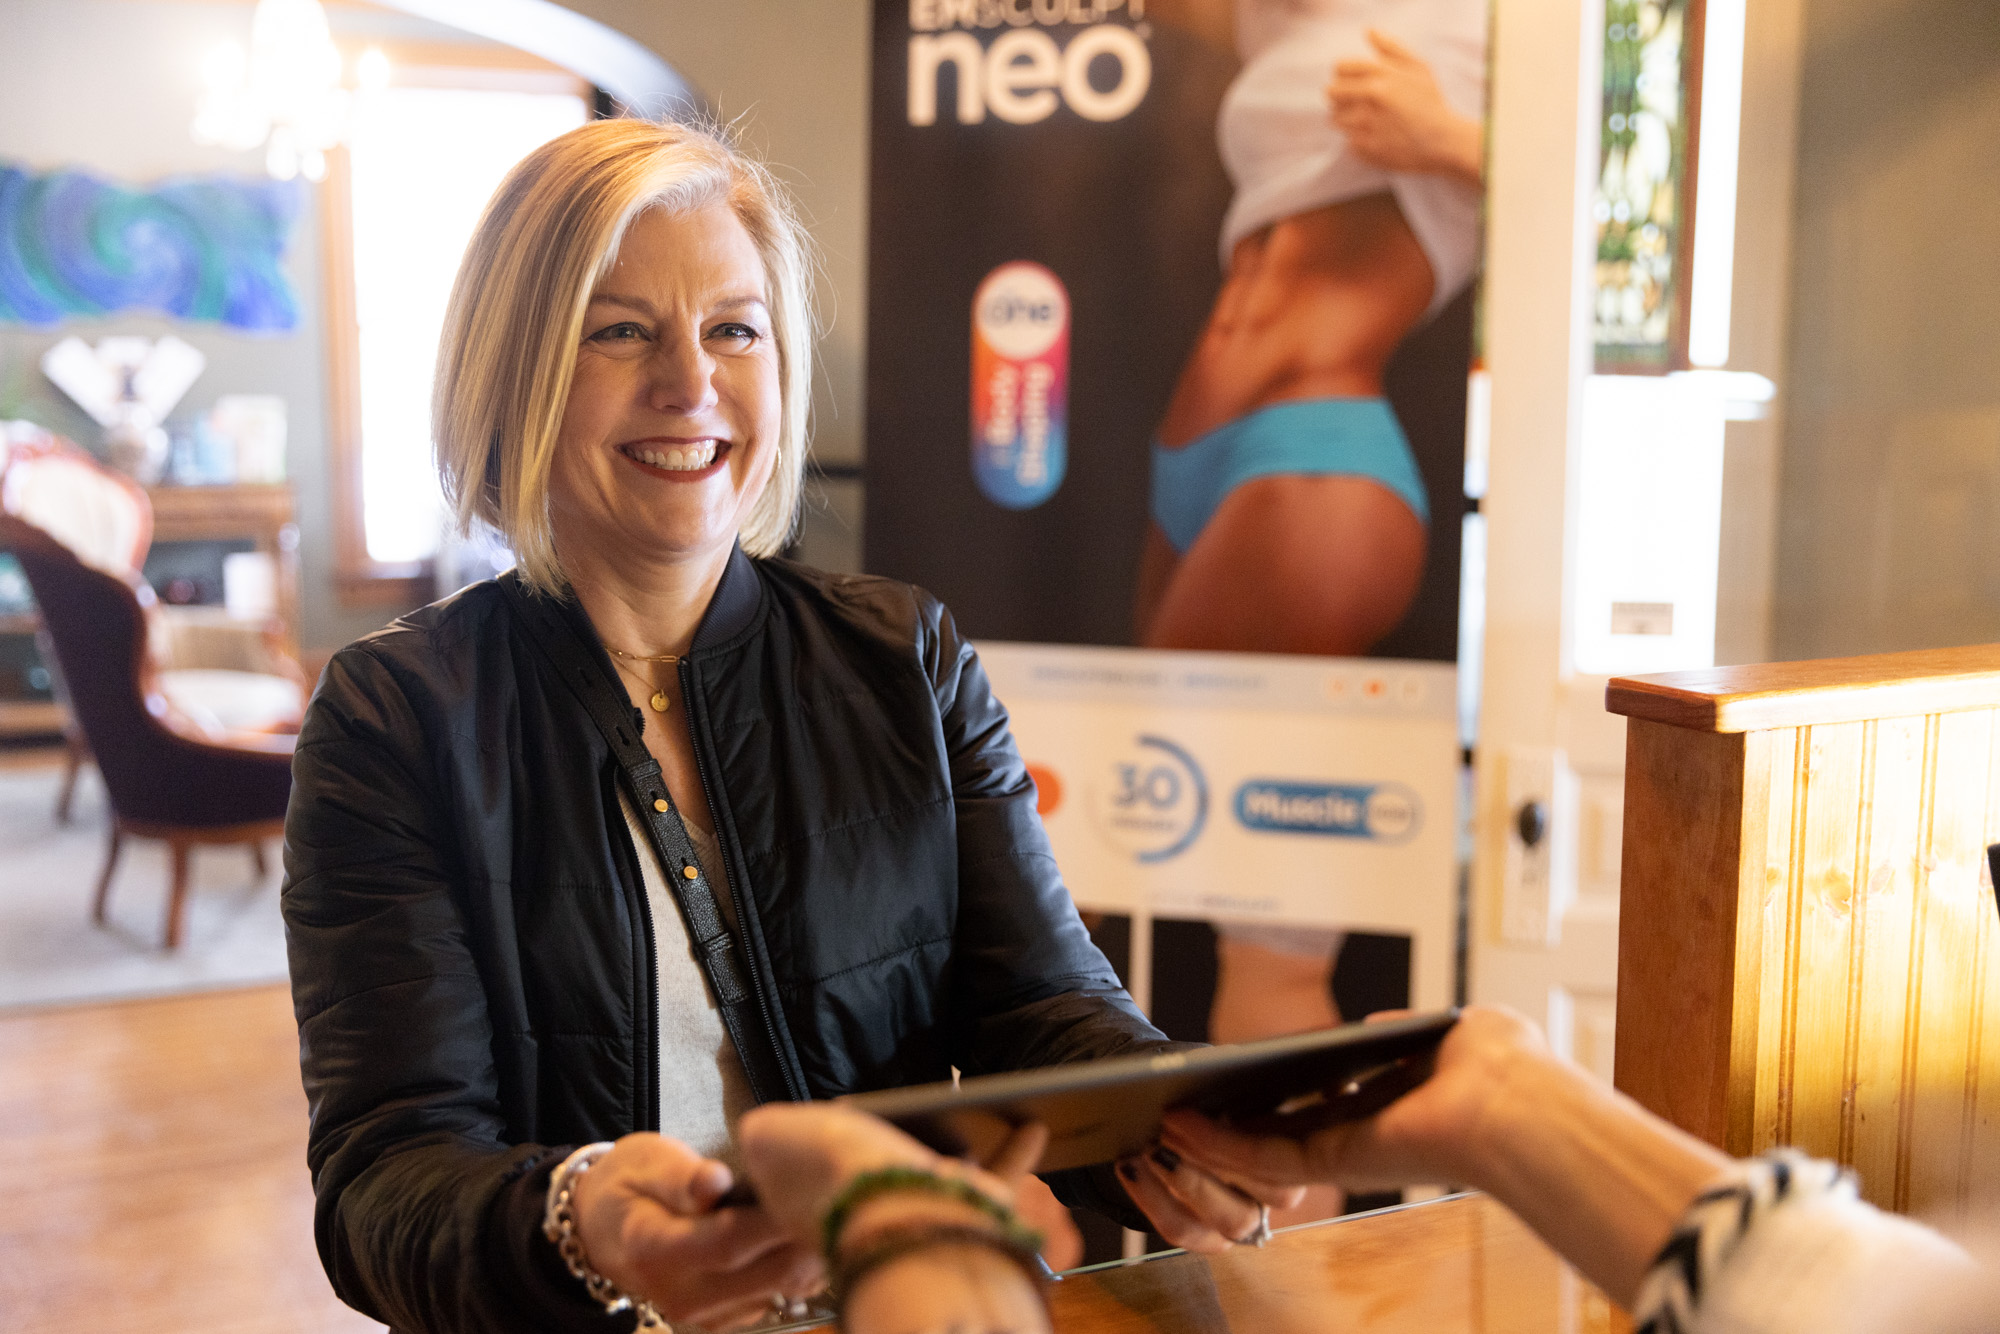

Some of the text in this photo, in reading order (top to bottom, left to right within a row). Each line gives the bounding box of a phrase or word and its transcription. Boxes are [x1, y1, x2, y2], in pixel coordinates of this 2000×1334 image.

[908, 25, 1151, 126] neo
[1112, 763, 1181, 811] 30
[1245, 788, 1360, 828] Muscle
